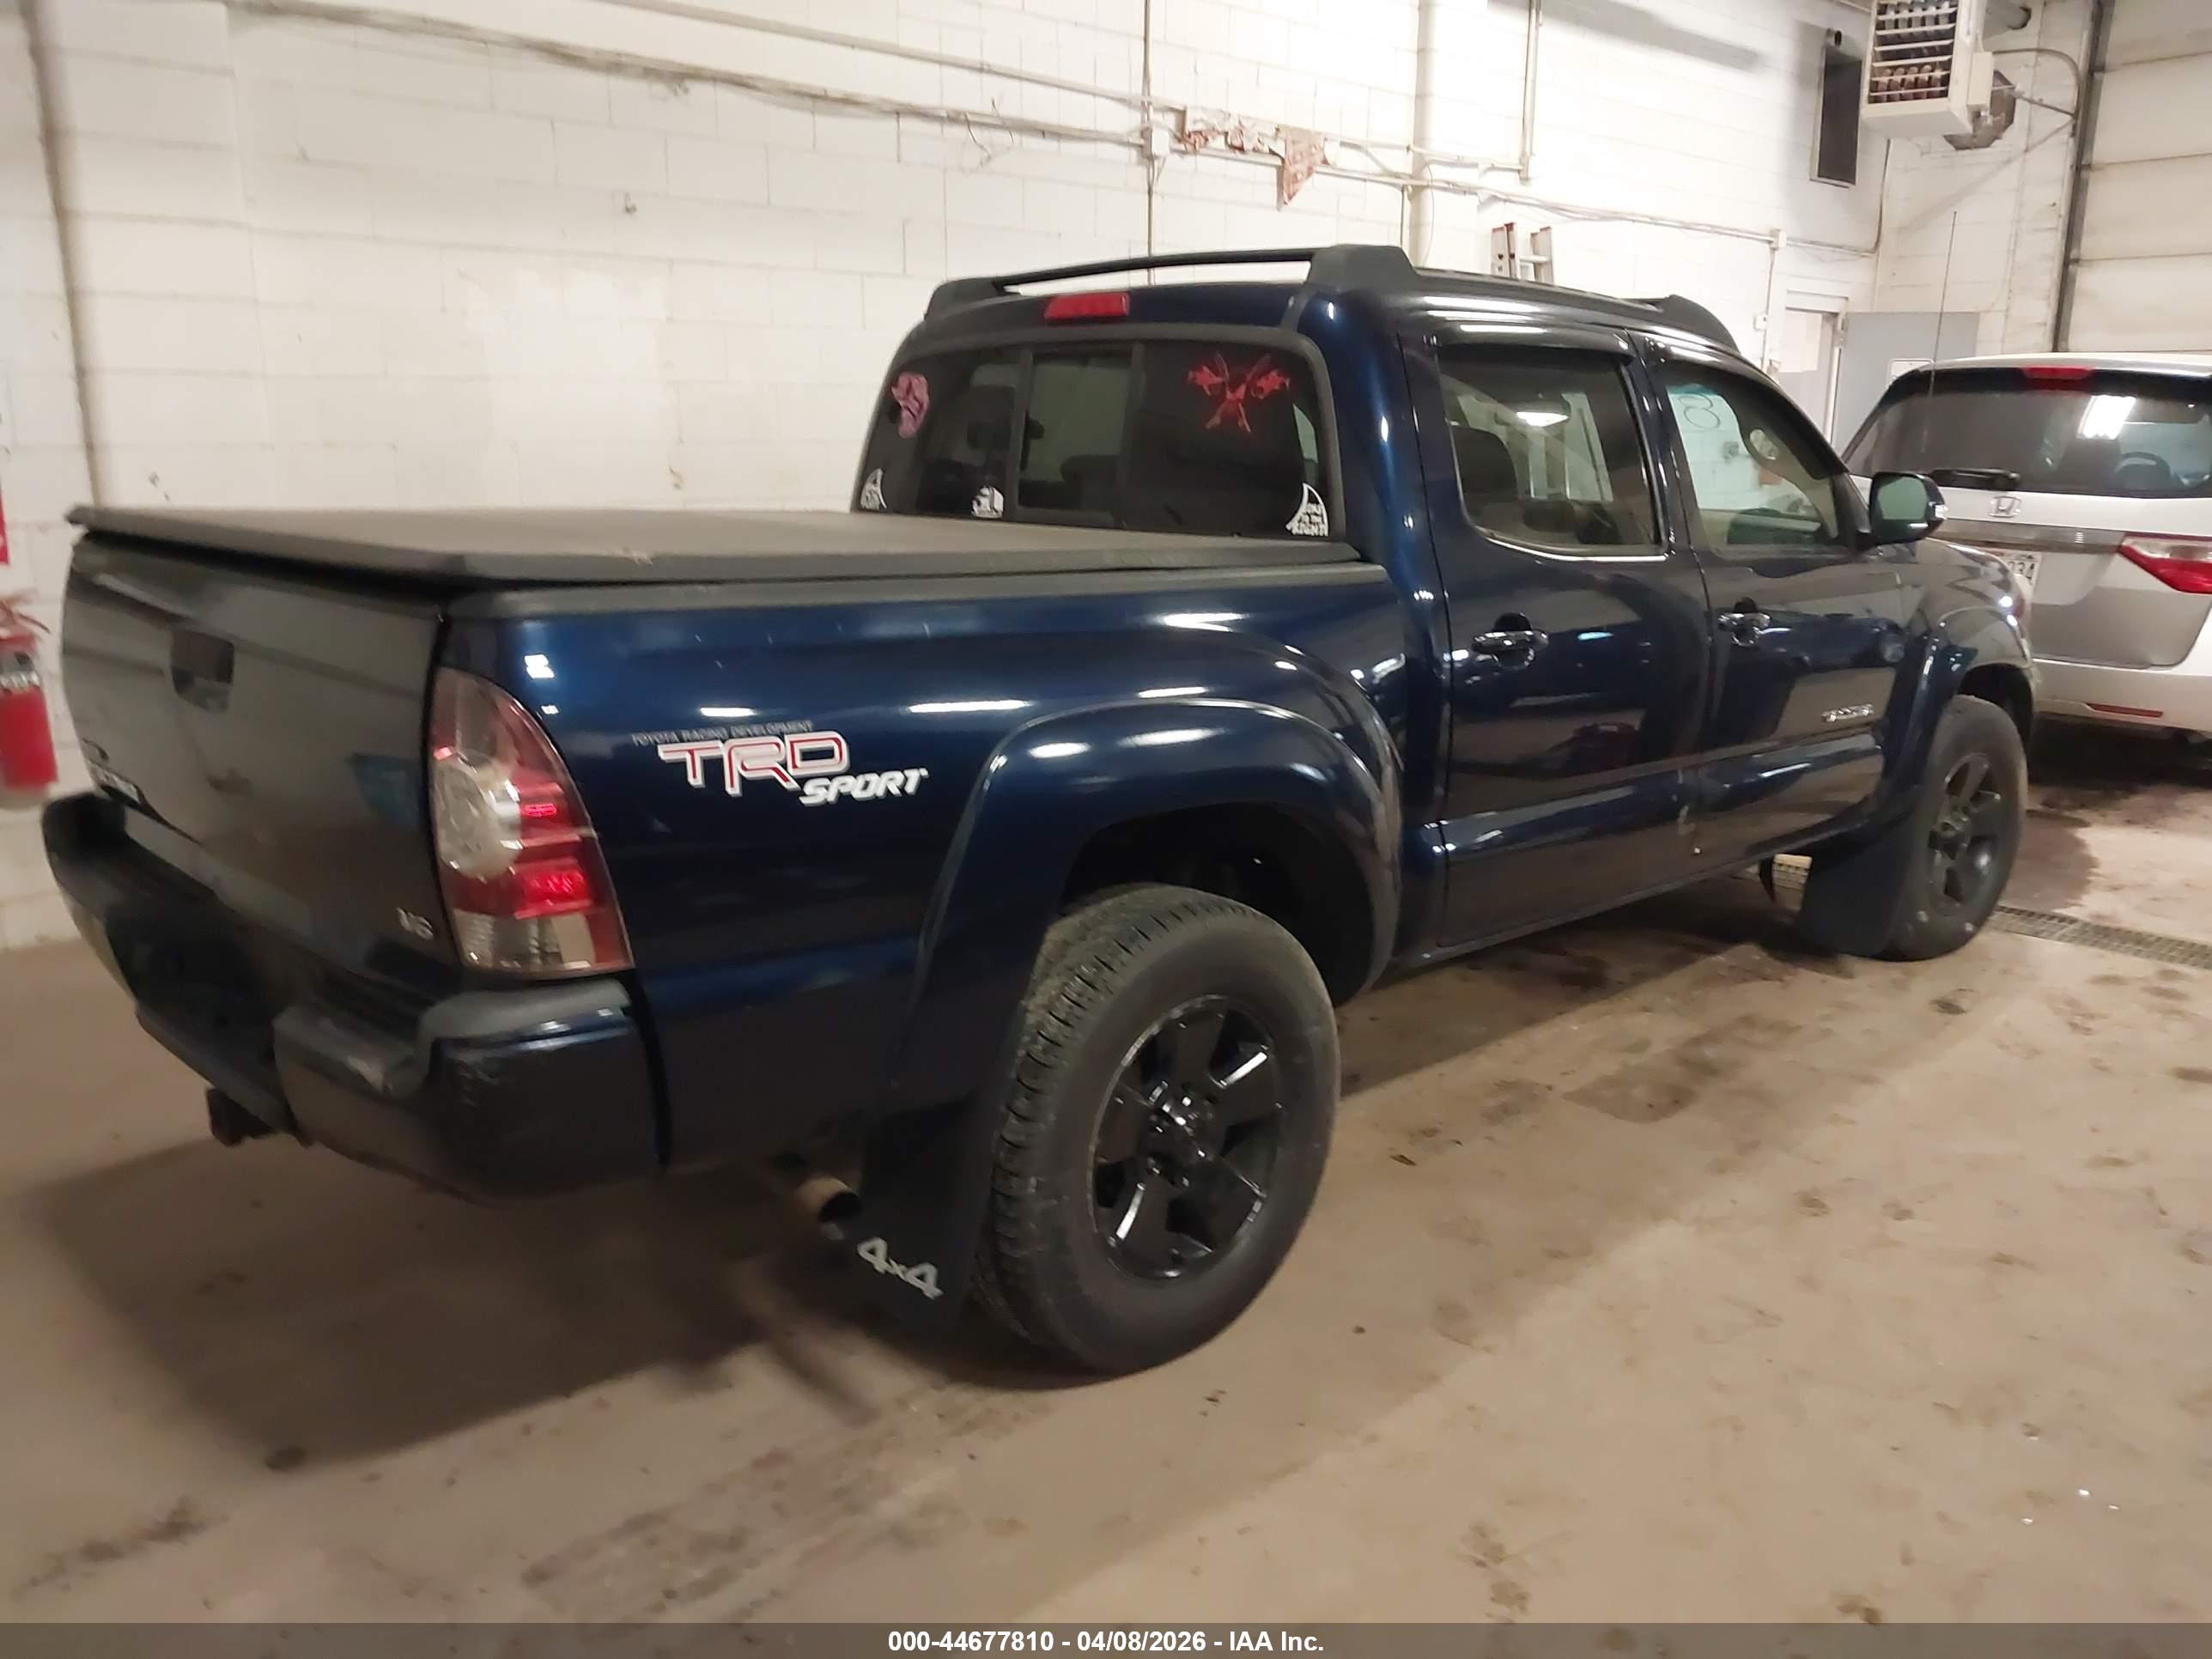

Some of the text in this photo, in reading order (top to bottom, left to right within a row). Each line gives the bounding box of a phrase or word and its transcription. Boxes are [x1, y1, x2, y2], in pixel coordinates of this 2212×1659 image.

[657, 731, 850, 797] TRD
[799, 768, 929, 807] SPORT
[396, 907, 434, 940] V6
